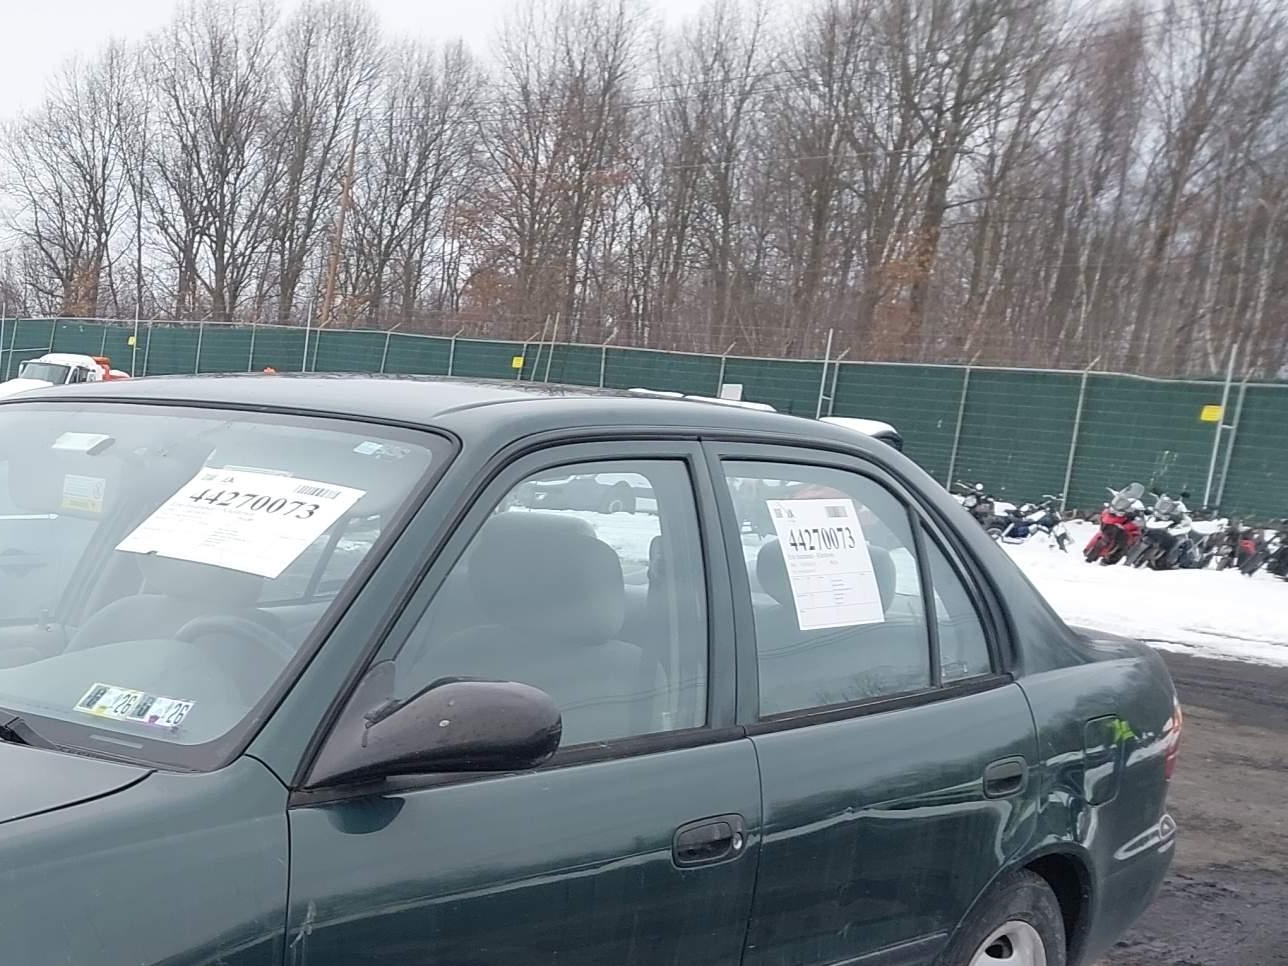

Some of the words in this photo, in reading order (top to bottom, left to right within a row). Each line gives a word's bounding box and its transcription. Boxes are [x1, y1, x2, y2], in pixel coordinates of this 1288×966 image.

[189, 487, 321, 521] 44270073
[789, 526, 856, 551] 44270073
[113, 693, 138, 715] 26
[166, 702, 190, 725] 26
